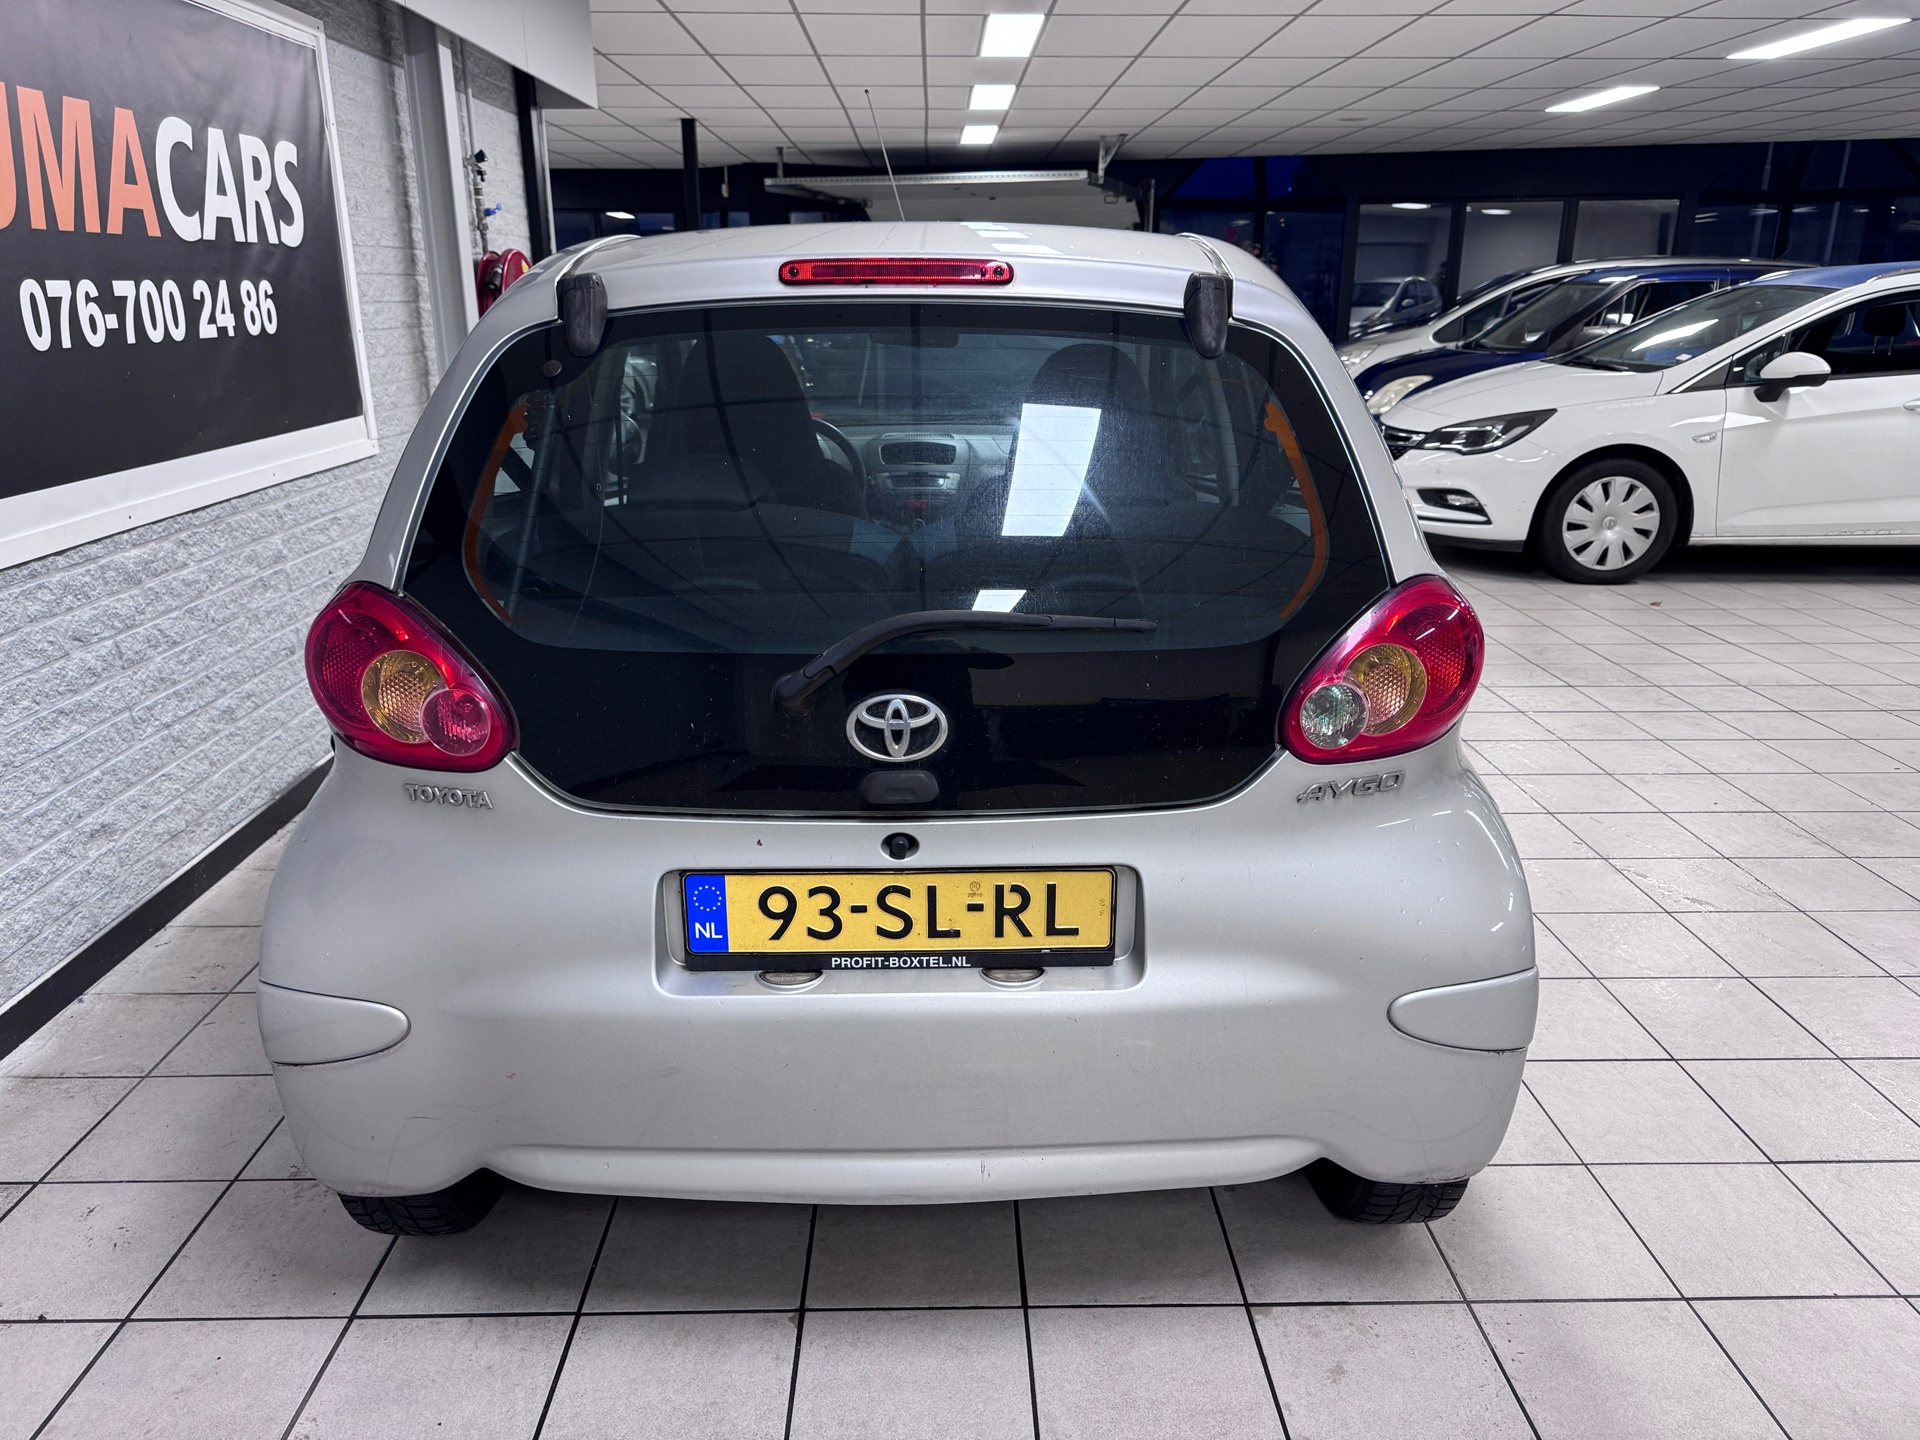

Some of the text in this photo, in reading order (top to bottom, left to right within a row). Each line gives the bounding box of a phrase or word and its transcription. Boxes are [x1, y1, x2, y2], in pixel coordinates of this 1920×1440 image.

[19, 278, 278, 352] 076-700 24 86
[404, 783, 494, 809] TOYOTA
[1296, 770, 1406, 803] AYGO
[757, 882, 1080, 941] 93-SL-RL
[694, 922, 723, 939] NL
[831, 956, 972, 968] PROFIT-BOXTEL.NL
